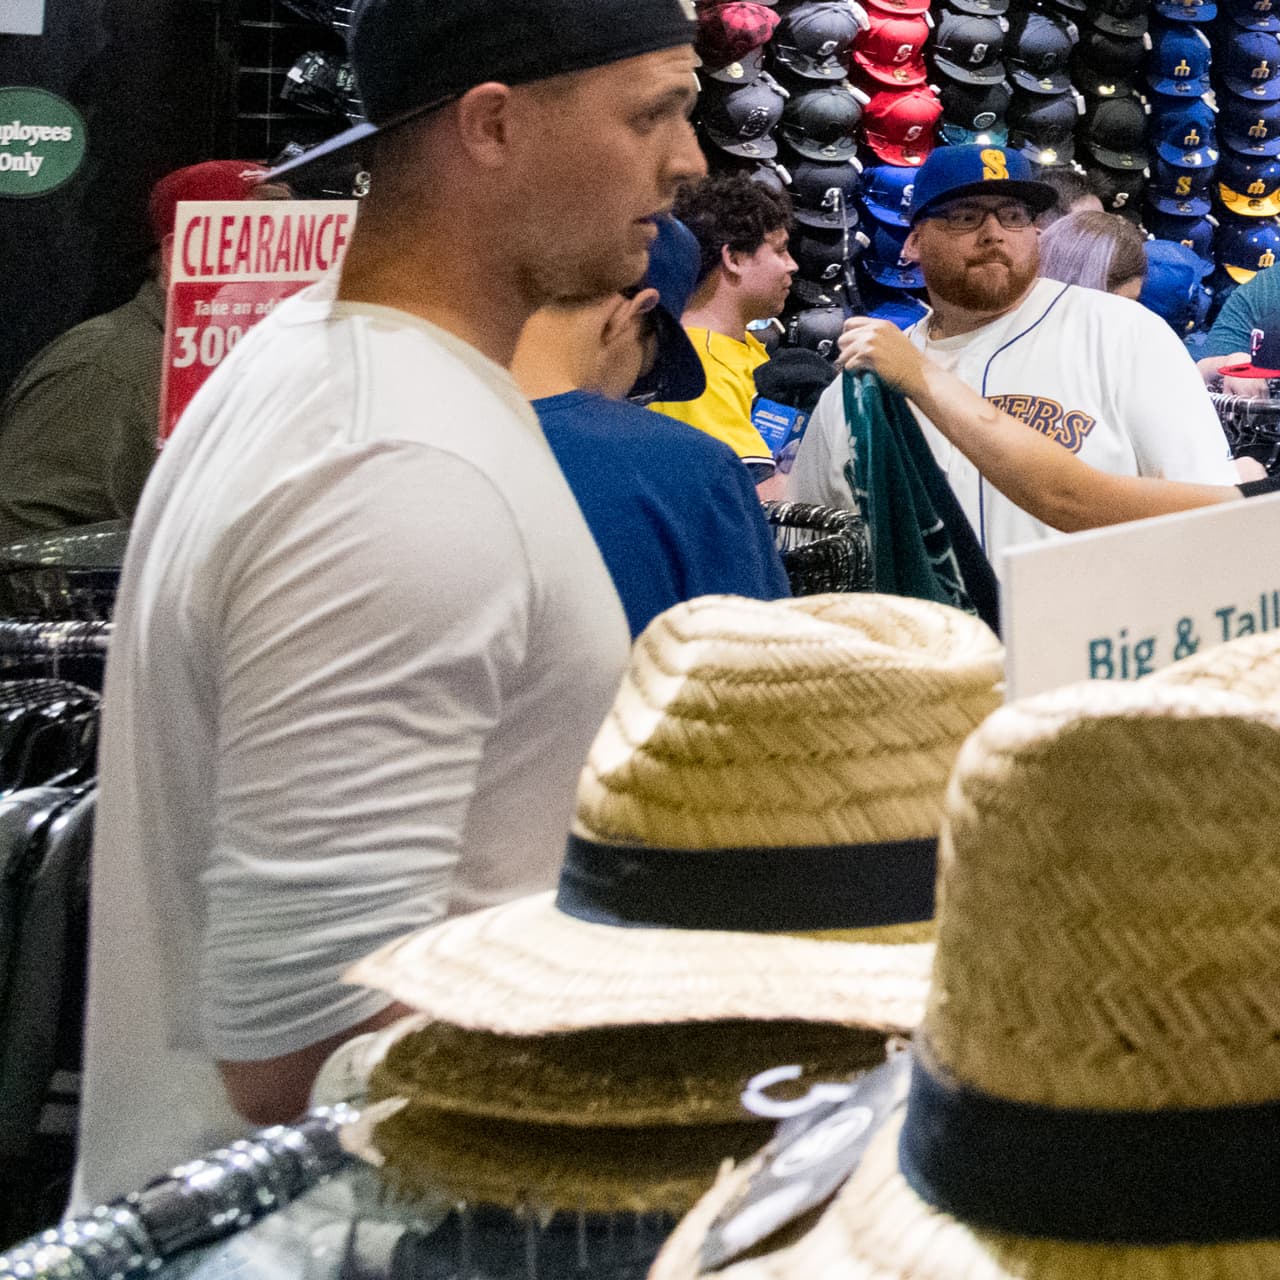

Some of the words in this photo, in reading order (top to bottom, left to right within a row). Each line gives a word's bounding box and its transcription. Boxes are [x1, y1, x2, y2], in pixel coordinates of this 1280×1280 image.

[0, 151, 45, 176] Only
[194, 300, 229, 316] Take
[231, 302, 251, 315] an
[1088, 629, 1156, 680] Big
[1173, 617, 1200, 661] &
[1214, 589, 1280, 642] Tall
